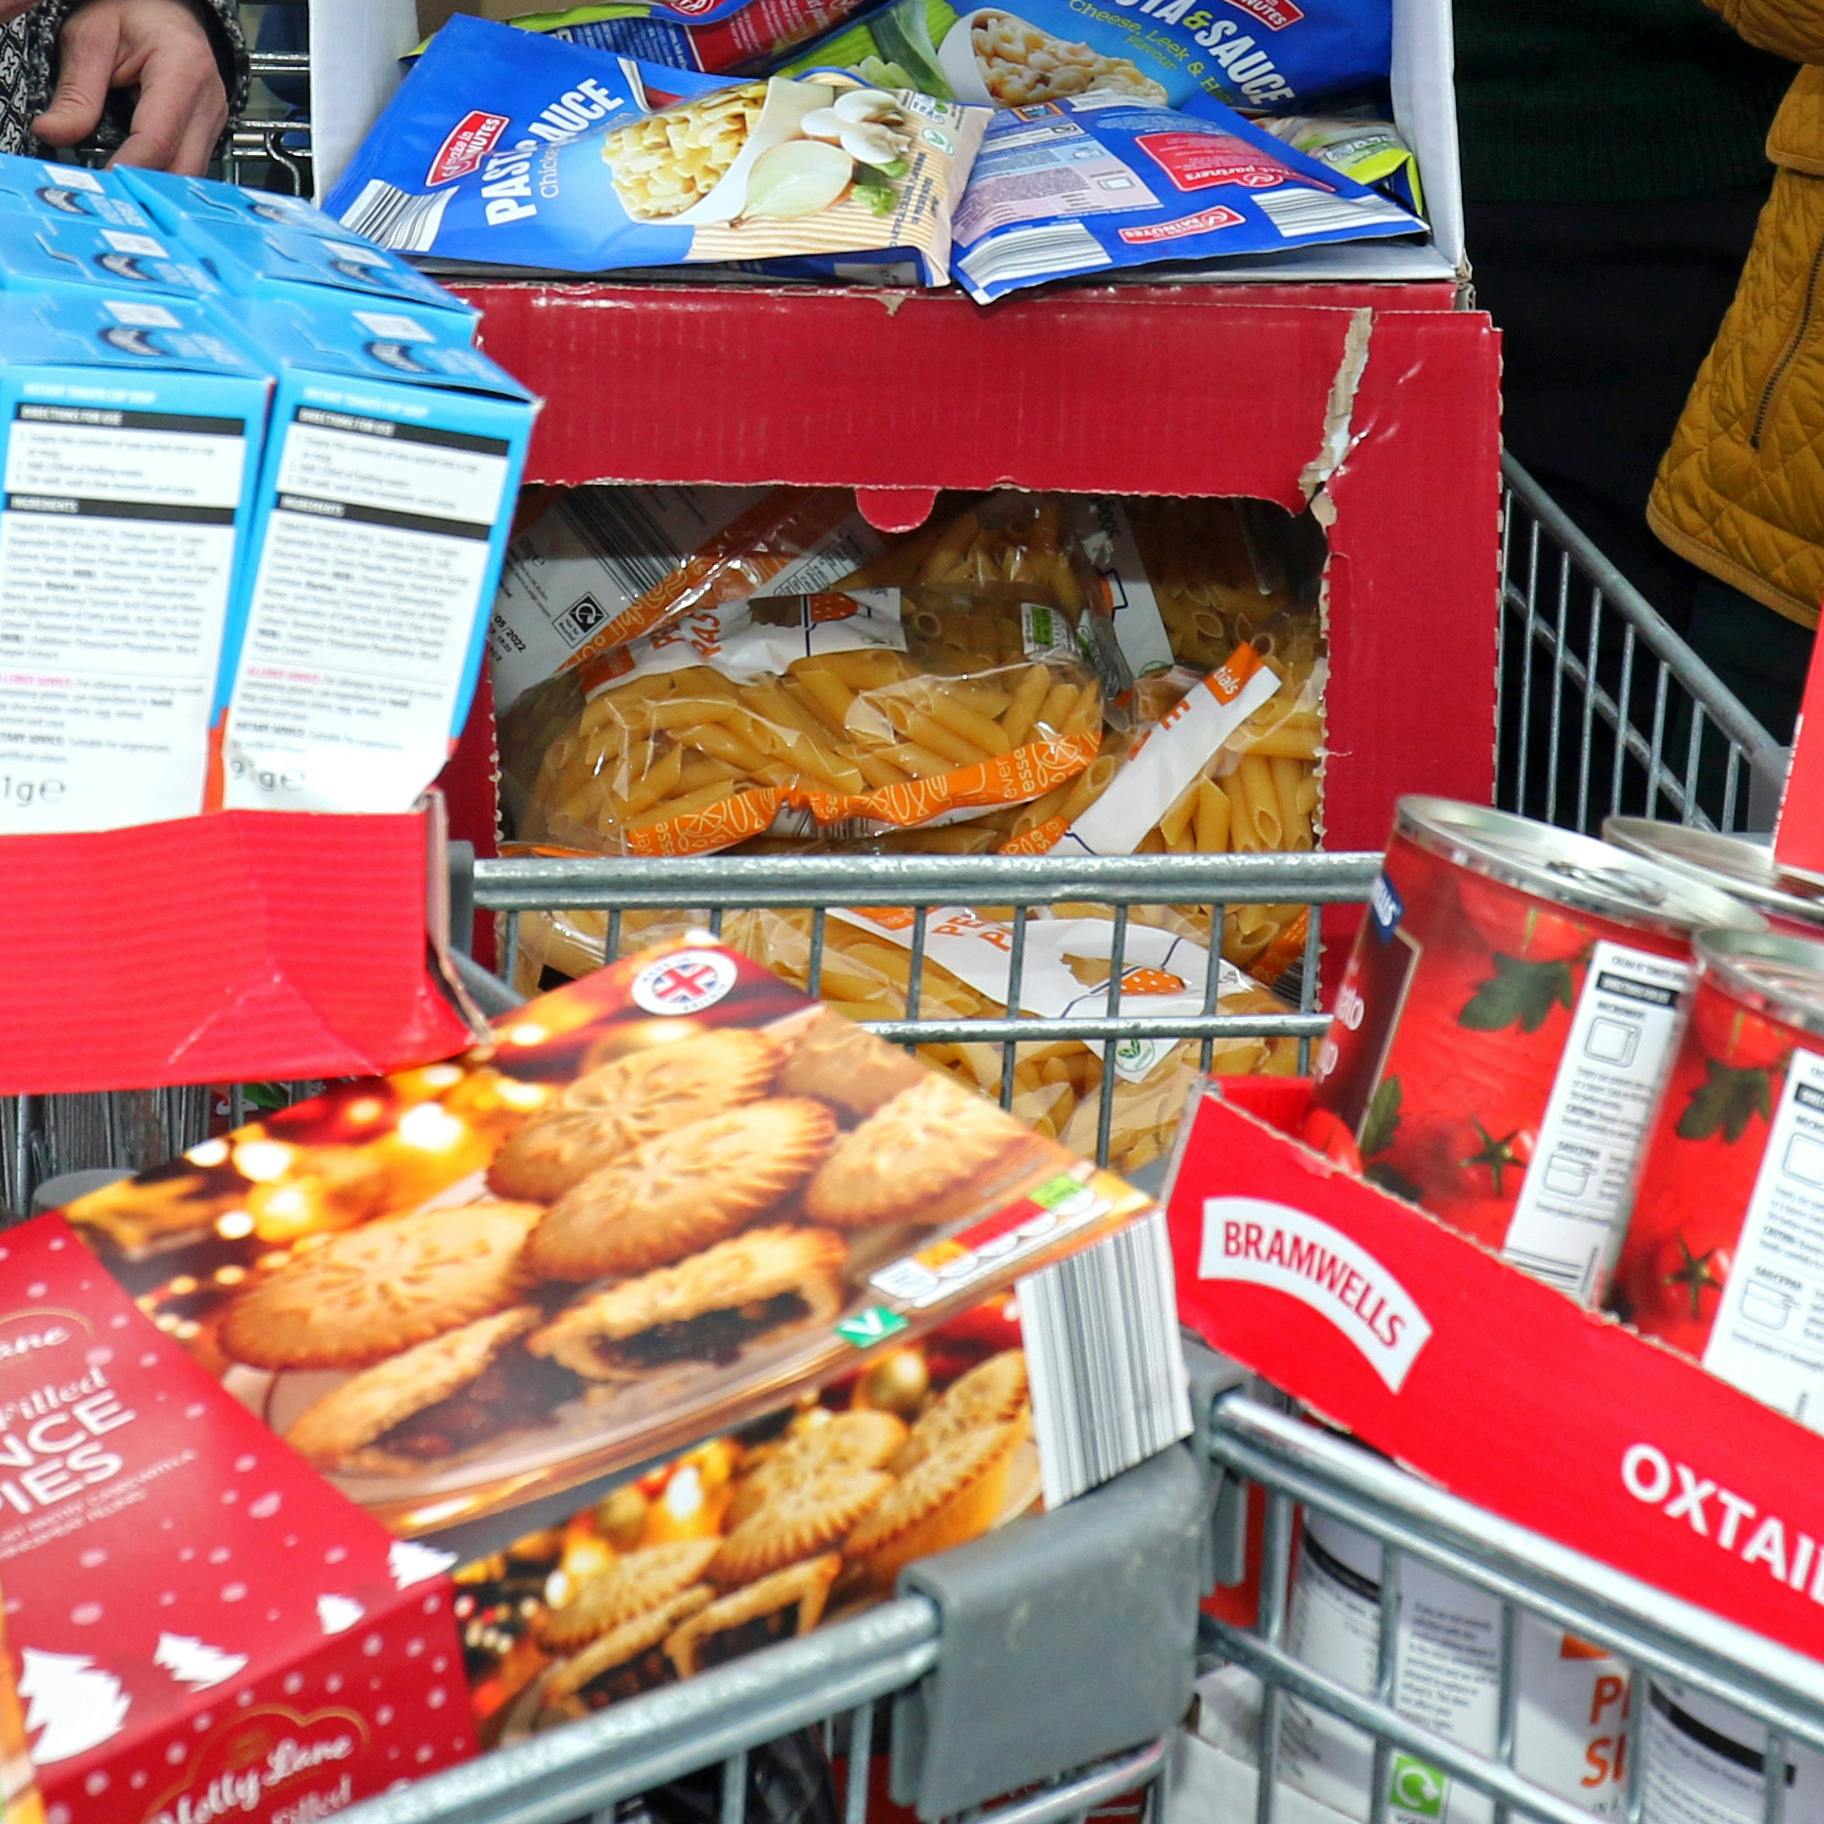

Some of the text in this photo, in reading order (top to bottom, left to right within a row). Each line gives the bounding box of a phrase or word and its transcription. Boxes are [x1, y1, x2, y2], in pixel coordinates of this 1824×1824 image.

[1145, 29, 1191, 61] Leek
[1194, 19, 1295, 105] SAUCE
[527, 78, 625, 144] AUCE
[1222, 1219, 1410, 1353] BRAMWELLS
[262, 1735, 353, 1786] Lane
